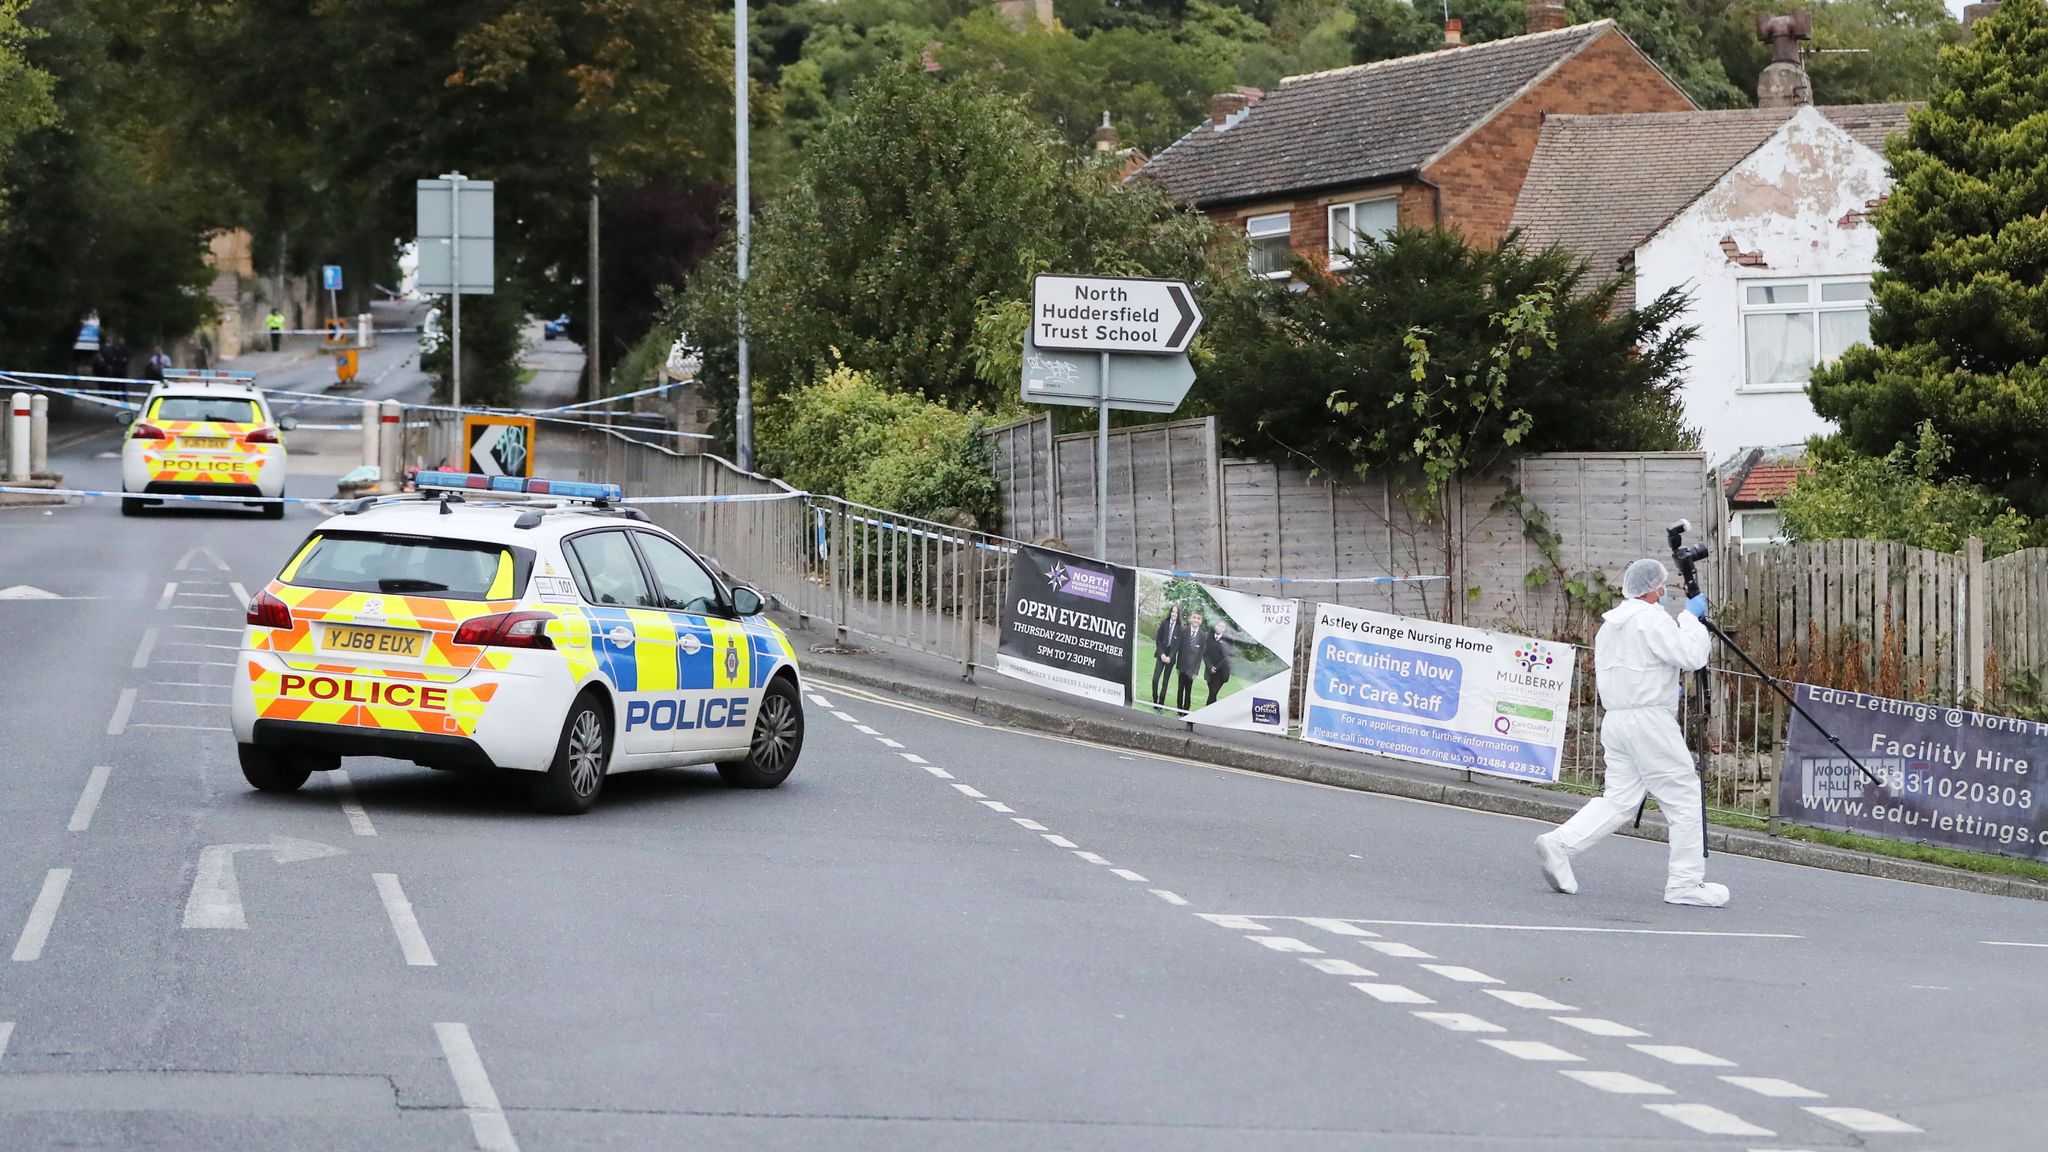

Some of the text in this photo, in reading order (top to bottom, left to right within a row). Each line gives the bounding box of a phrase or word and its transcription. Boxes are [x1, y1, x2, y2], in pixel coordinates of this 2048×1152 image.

[1075, 285, 1127, 301] North
[1043, 304, 1159, 323] Huddersfield
[1041, 323, 1158, 342] Trust School
[162, 459, 246, 472] POLICE
[558, 580, 573, 594] 101
[1073, 572, 1110, 588] NORTH
[1017, 598, 1126, 639] OPEN EVENING
[1261, 604, 1292, 614] TRUST
[1275, 616, 1290, 625] US
[331, 630, 415, 654] YJ68 EUX
[1013, 622, 1123, 657] THURSDAY 22ND SEPTEMBER
[1321, 614, 1493, 653] Astley Grange Nursing Home
[1036, 645, 1096, 668] 5PM TO 7.30PM
[1326, 644, 1454, 681] Recruiting Now
[1496, 670, 1564, 691] MULBERRY
[280, 674, 448, 711] POLICE
[1329, 678, 1442, 712] For Care Staff
[625, 697, 750, 732] POLICE
[1254, 705, 1277, 714] Ofsted
[1497, 704, 1517, 713] Good
[1808, 686, 1938, 722] Edu-Lettings
[1945, 708, 1963, 728] @
[1970, 713, 2028, 734] North
[1341, 713, 1519, 753] For an application or further information
[1527, 722, 1550, 734] Quality
[1313, 726, 1547, 776] Please call into reception or ring us on 01484 428 322
[1871, 733, 2028, 774] Facility Hire
[1819, 780, 1849, 791] HALL
